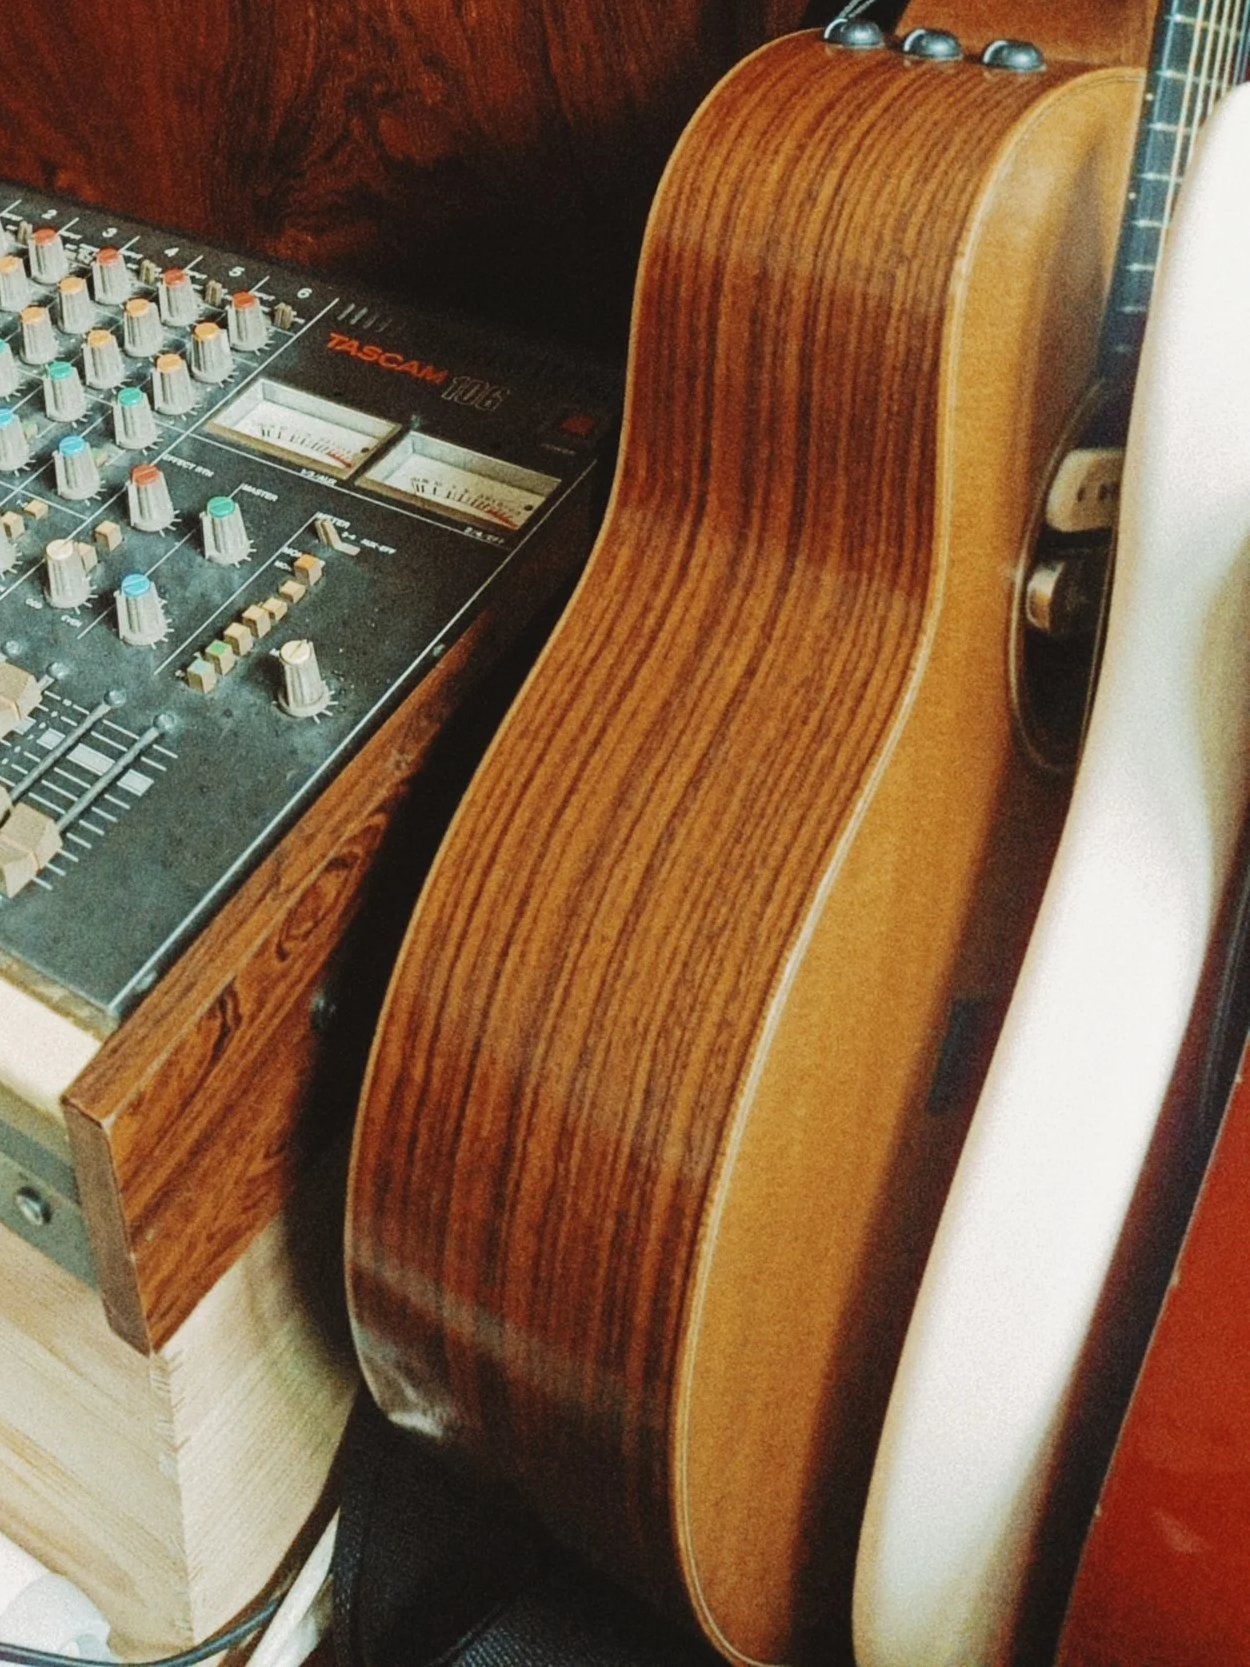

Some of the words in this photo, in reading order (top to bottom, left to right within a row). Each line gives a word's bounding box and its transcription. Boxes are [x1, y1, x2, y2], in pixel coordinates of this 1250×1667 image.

[228, 266, 246, 277] 5
[297, 287, 312, 298] 6
[327, 332, 449, 384] TASCAM
[441, 376, 504, 411] 106
[161, 453, 196, 470] EFFECT
[241, 483, 278, 502] MASTER
